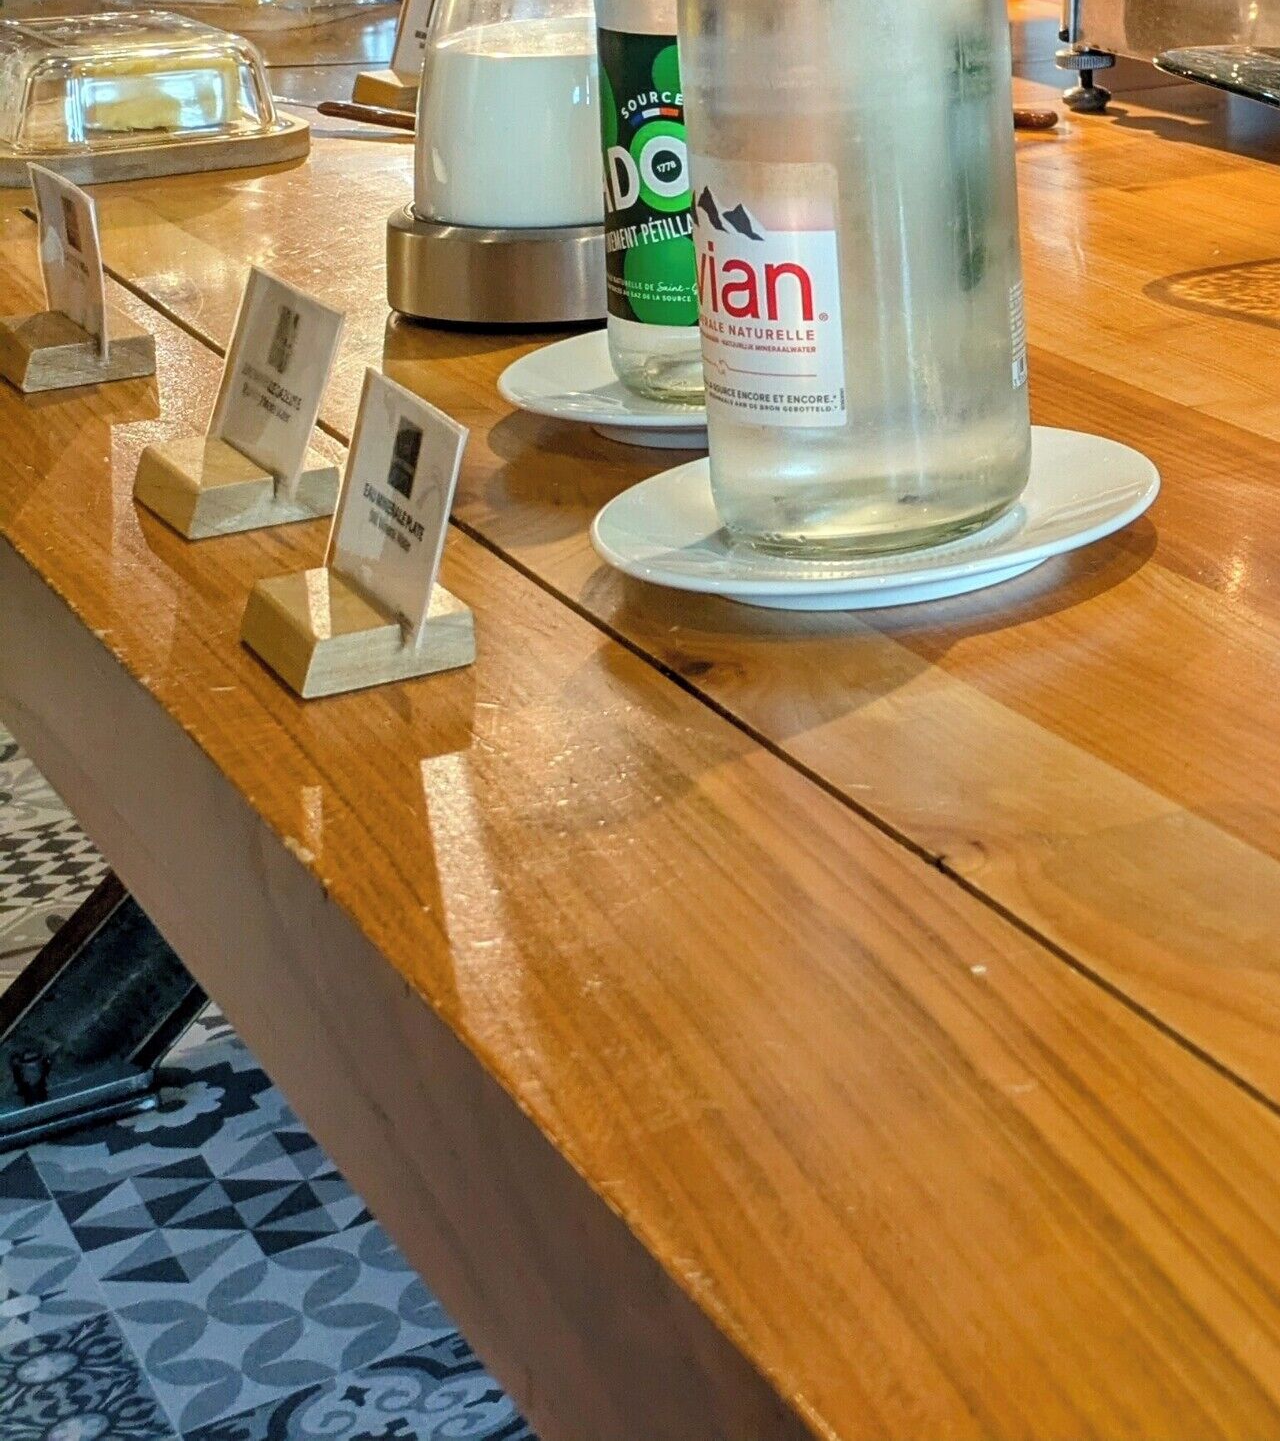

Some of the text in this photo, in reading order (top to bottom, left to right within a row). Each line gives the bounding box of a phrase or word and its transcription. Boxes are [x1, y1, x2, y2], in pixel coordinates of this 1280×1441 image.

[621, 91, 684, 119] SOURCE
[656, 160, 677, 173] 1778
[728, 325, 815, 341] NATURELLE
[737, 389, 771, 403] ENCORE
[773, 394, 784, 403] ET
